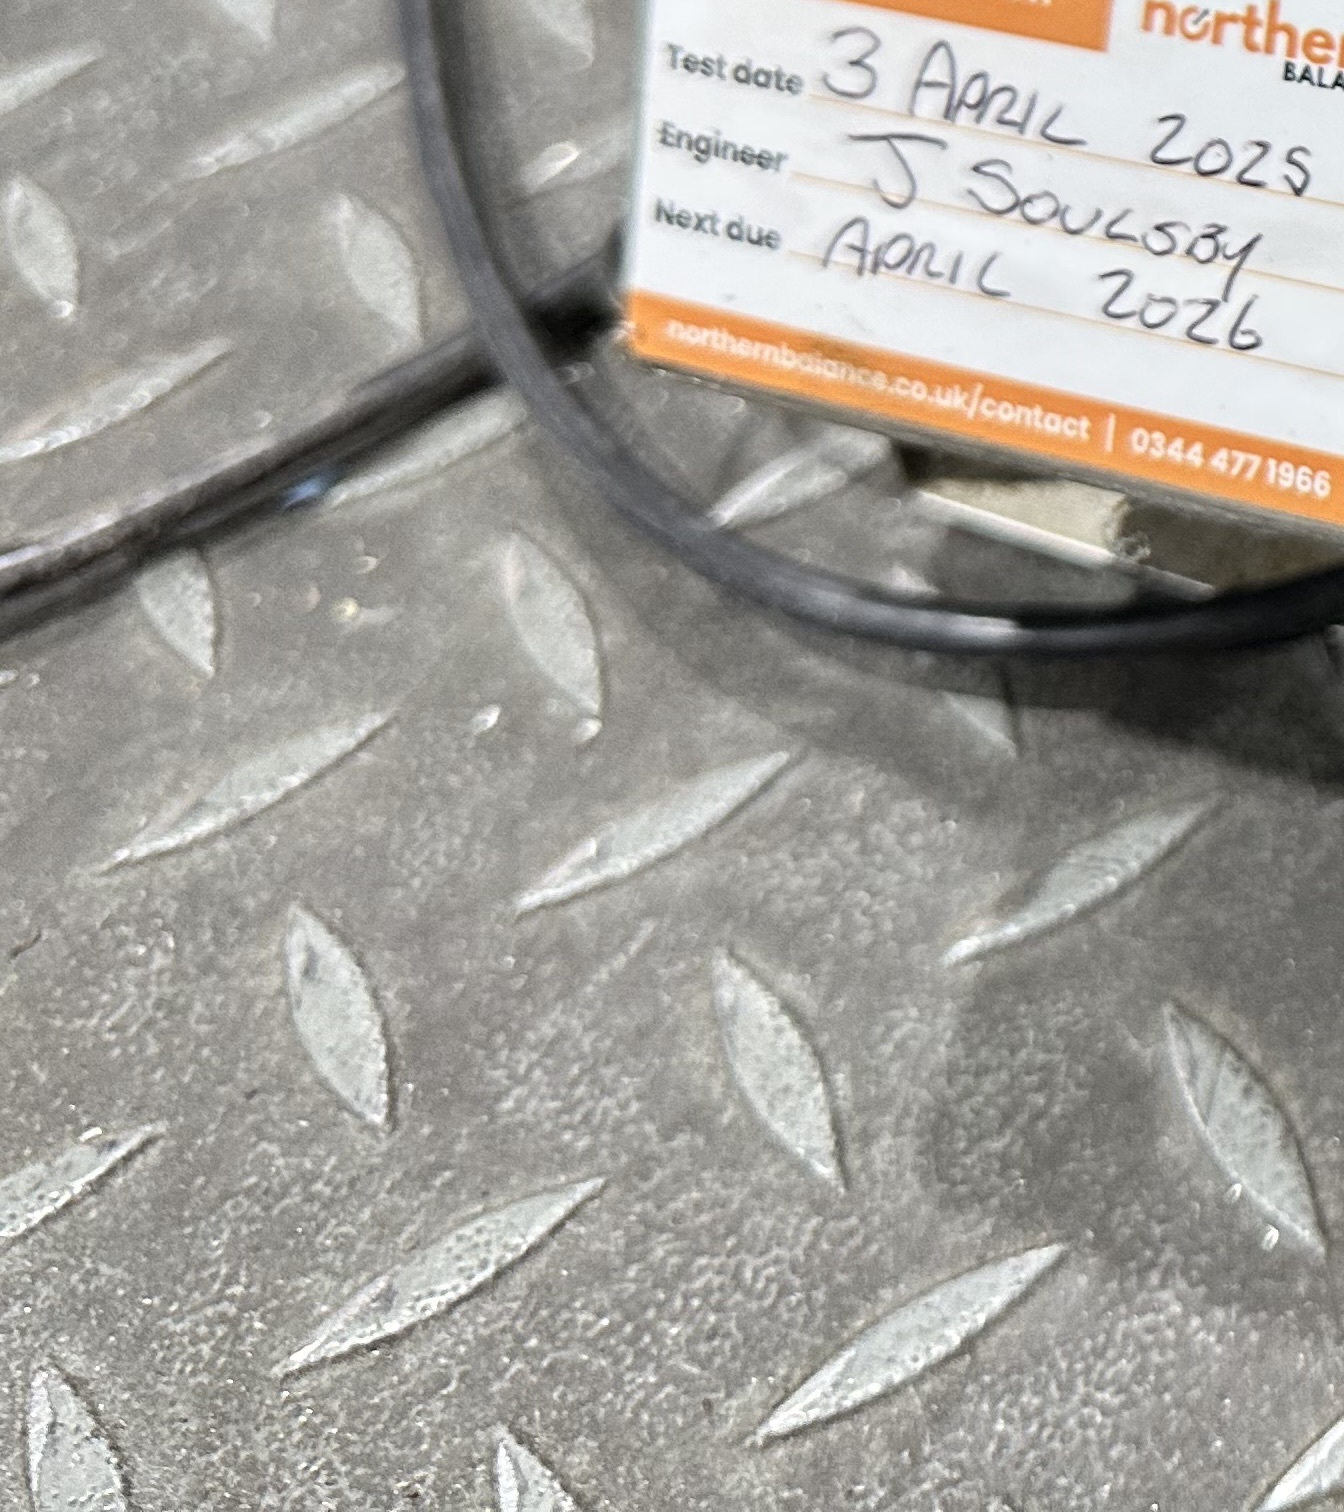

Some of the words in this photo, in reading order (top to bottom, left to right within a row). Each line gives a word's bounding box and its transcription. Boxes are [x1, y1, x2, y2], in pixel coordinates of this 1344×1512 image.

[665, 43, 727, 80] Test
[731, 55, 804, 96] date
[656, 117, 790, 174] Engineer
[821, 25, 881, 100] 3
[1150, 113, 1313, 198] 2025
[849, 131, 949, 210] J
[655, 197, 721, 241] Next
[727, 213, 782, 252] due
[1098, 267, 1264, 352] 2026
[665, 315, 1092, 444] northernbalance.co.uk/contact
[1130, 426, 1206, 471] 0344
